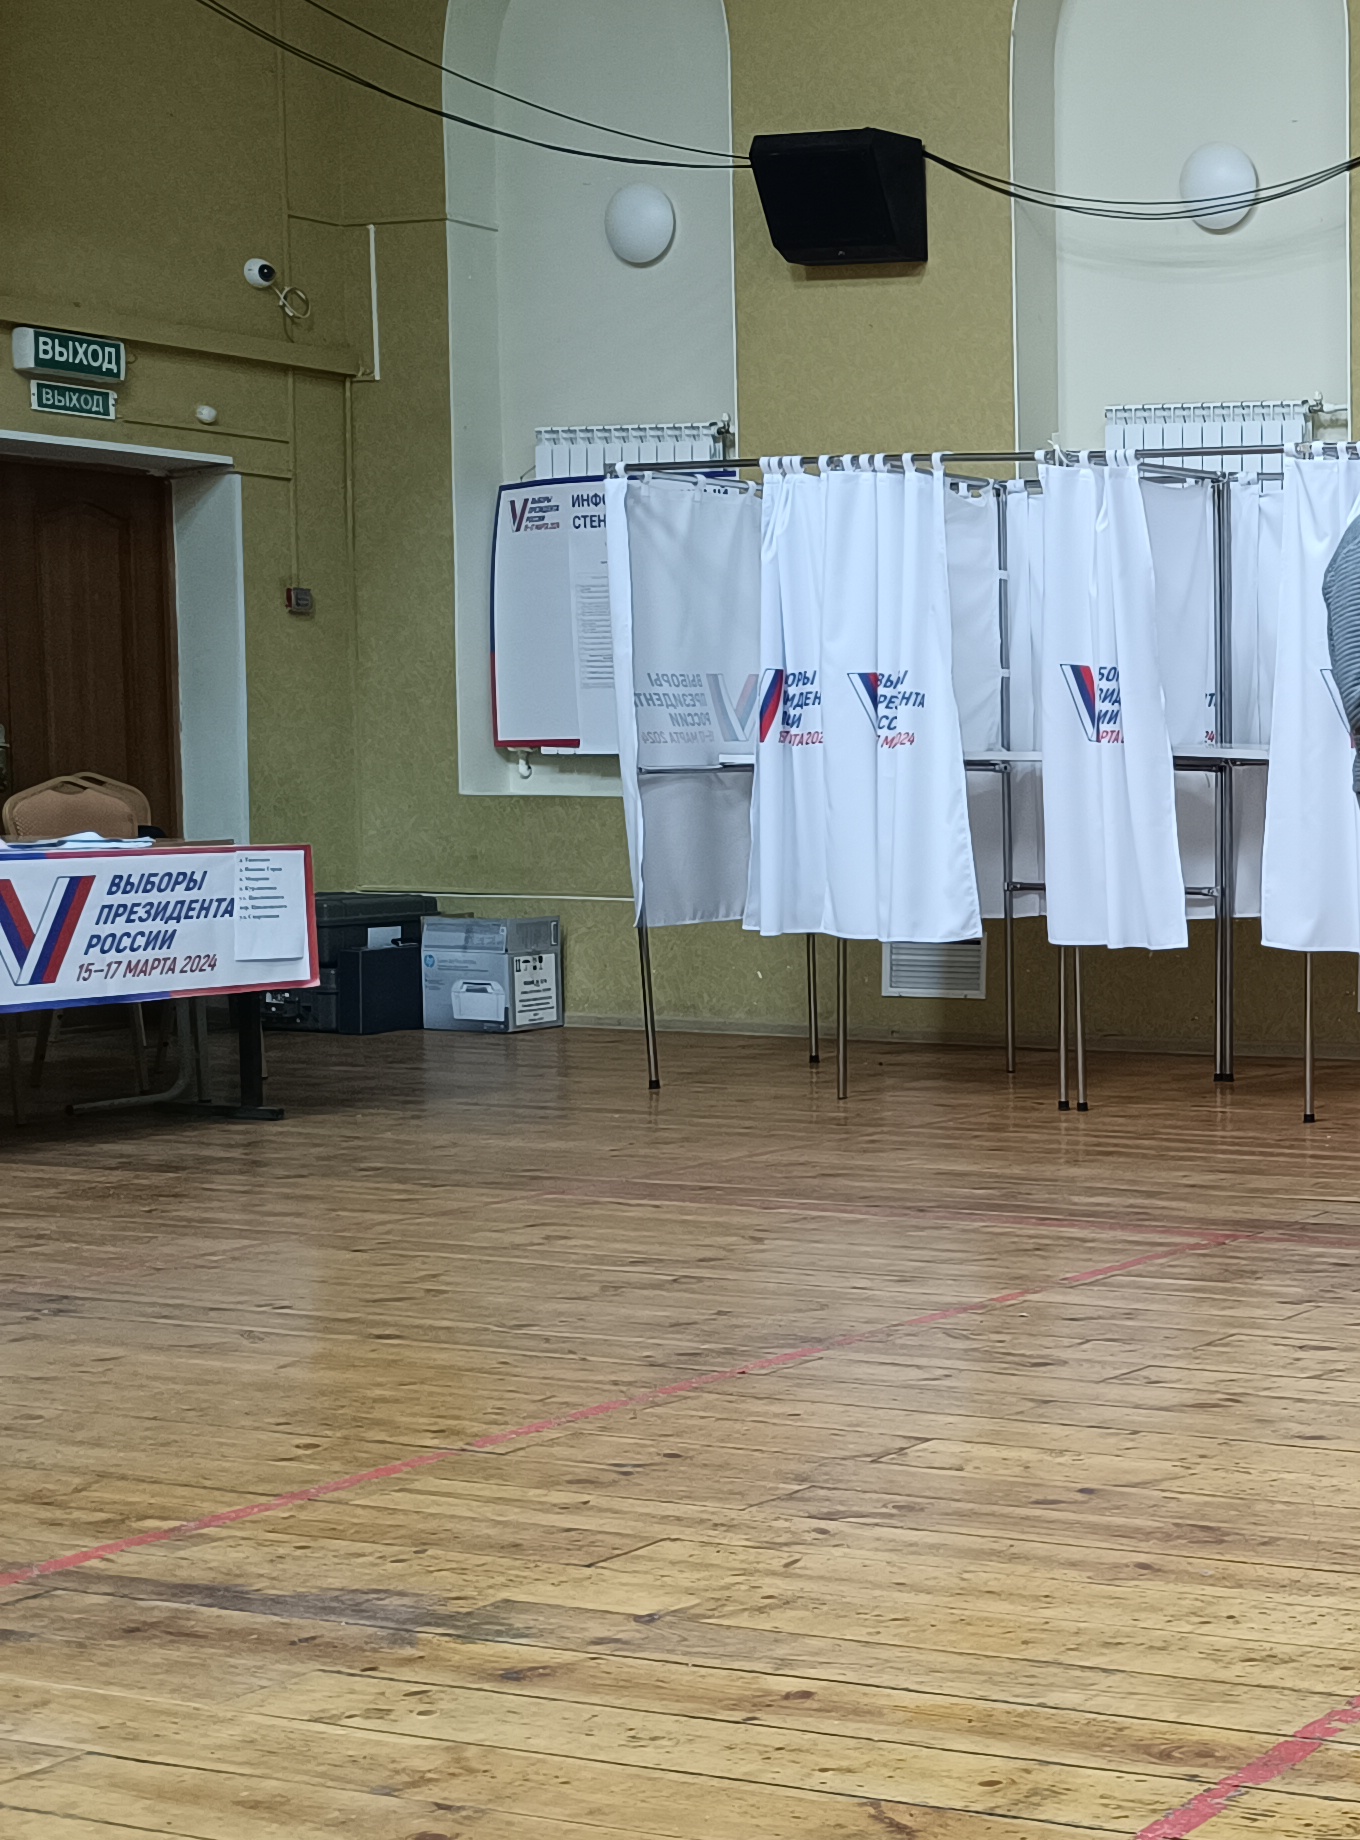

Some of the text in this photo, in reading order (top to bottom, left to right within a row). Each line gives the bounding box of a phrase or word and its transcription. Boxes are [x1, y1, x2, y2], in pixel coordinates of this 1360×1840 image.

[39, 336, 118, 373] ВЫХОД
[42, 388, 104, 413] ВЫХОД
[106, 870, 208, 895] ВЫБОРЫ
[95, 897, 235, 925] ПРЕЗИДЕНТА
[84, 929, 177, 955] РОССИИ
[123, 957, 178, 978] МАРТА
[180, 953, 218, 975] 2024
